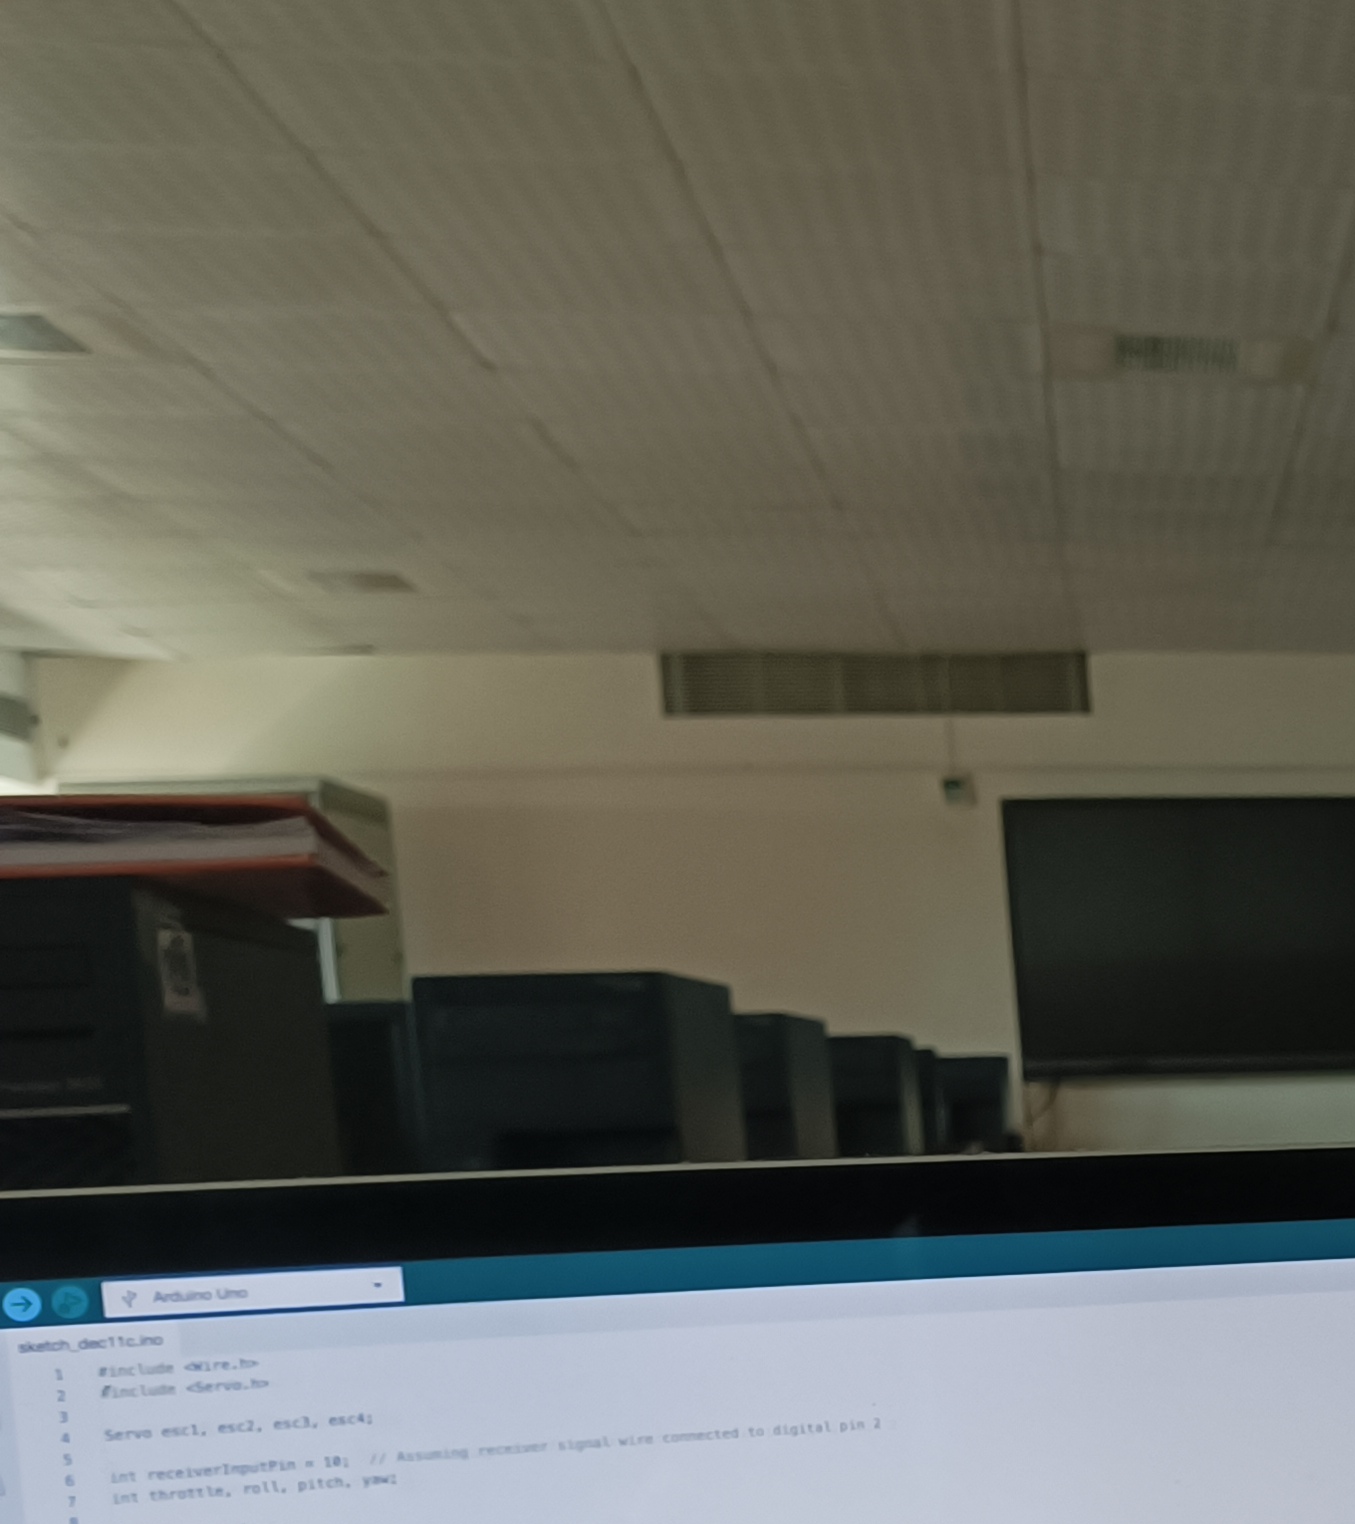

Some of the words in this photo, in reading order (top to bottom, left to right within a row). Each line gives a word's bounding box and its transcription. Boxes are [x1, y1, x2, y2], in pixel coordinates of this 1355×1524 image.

[152, 1286, 211, 1304] Arduino
[215, 1285, 249, 1300] Uno
[55, 1369, 63, 1382] 1
[56, 1390, 67, 1404] 2
[60, 1432, 71, 1446] 4
[65, 1474, 75, 1488] 6
[67, 1495, 77, 1509] 7
